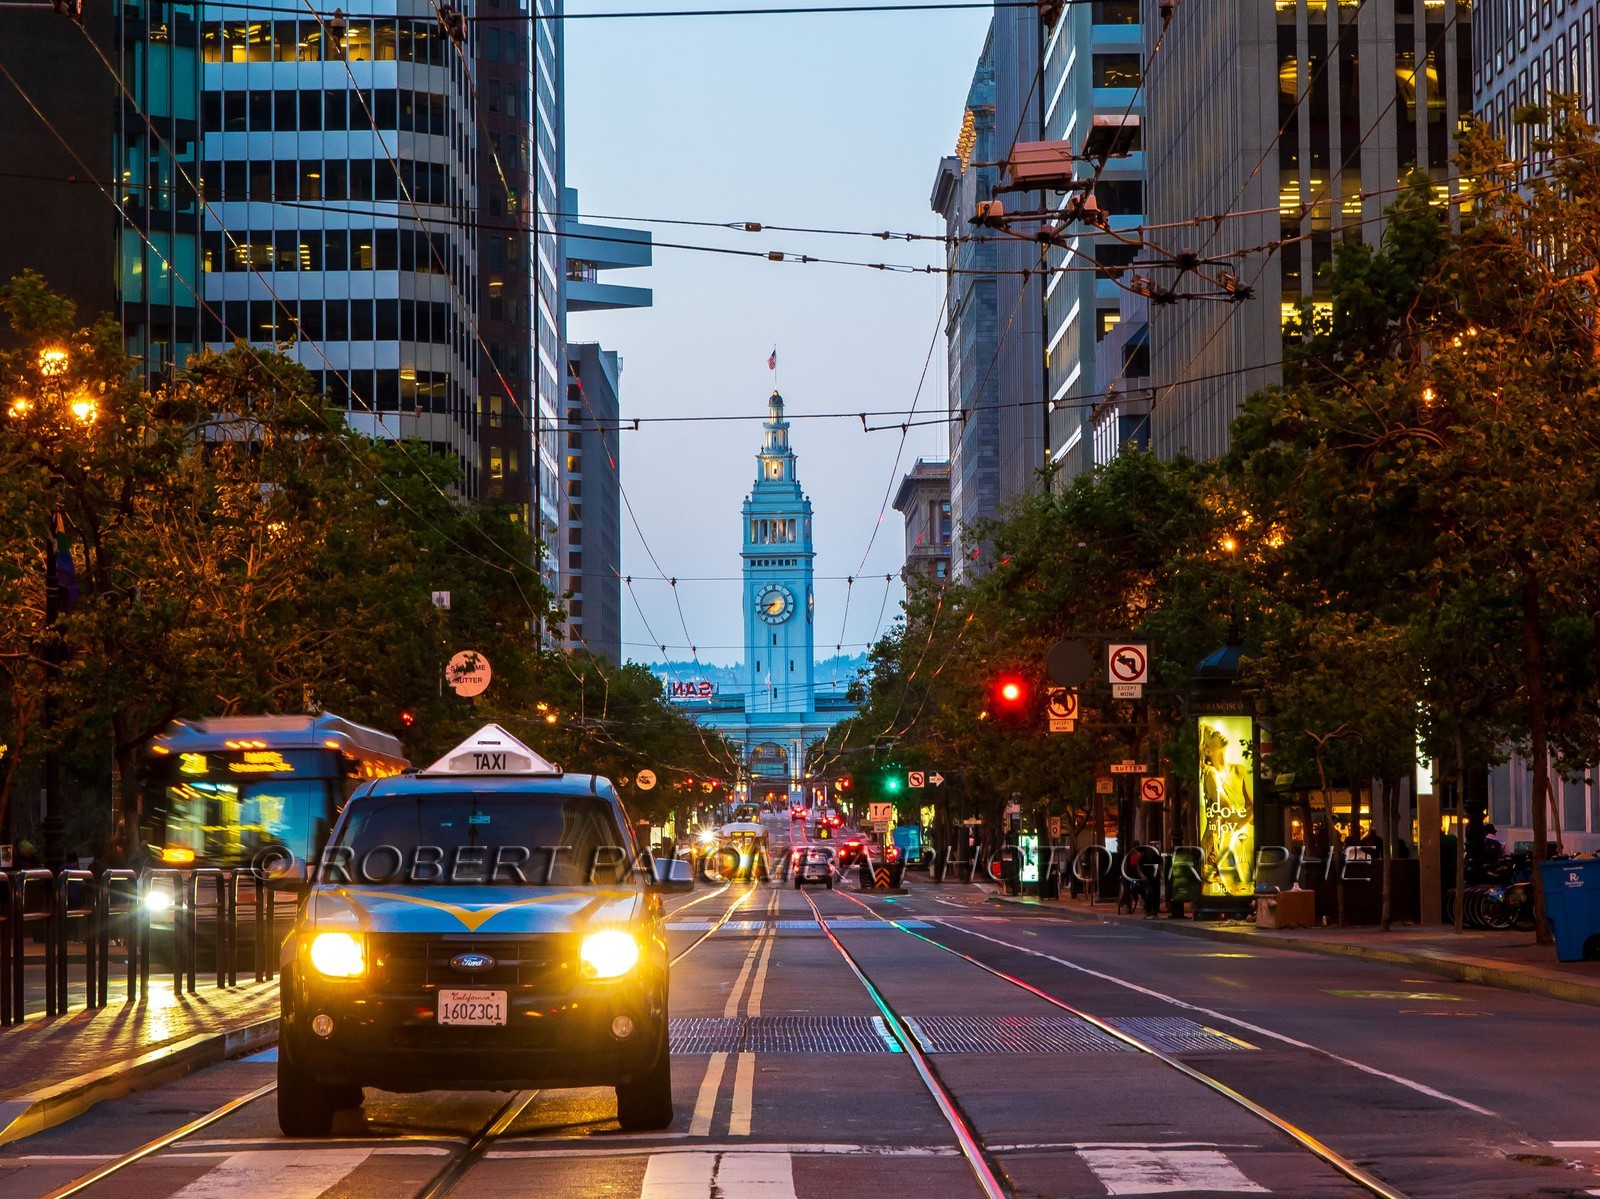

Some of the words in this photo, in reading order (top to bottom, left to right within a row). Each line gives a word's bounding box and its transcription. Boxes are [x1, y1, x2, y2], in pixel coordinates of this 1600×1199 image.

[473, 753, 506, 770] TAXI
[1208, 820, 1217, 831] in
[462, 957, 484, 967] Ford
[452, 992, 490, 1003] California
[442, 1003, 502, 1020] 16023C1
